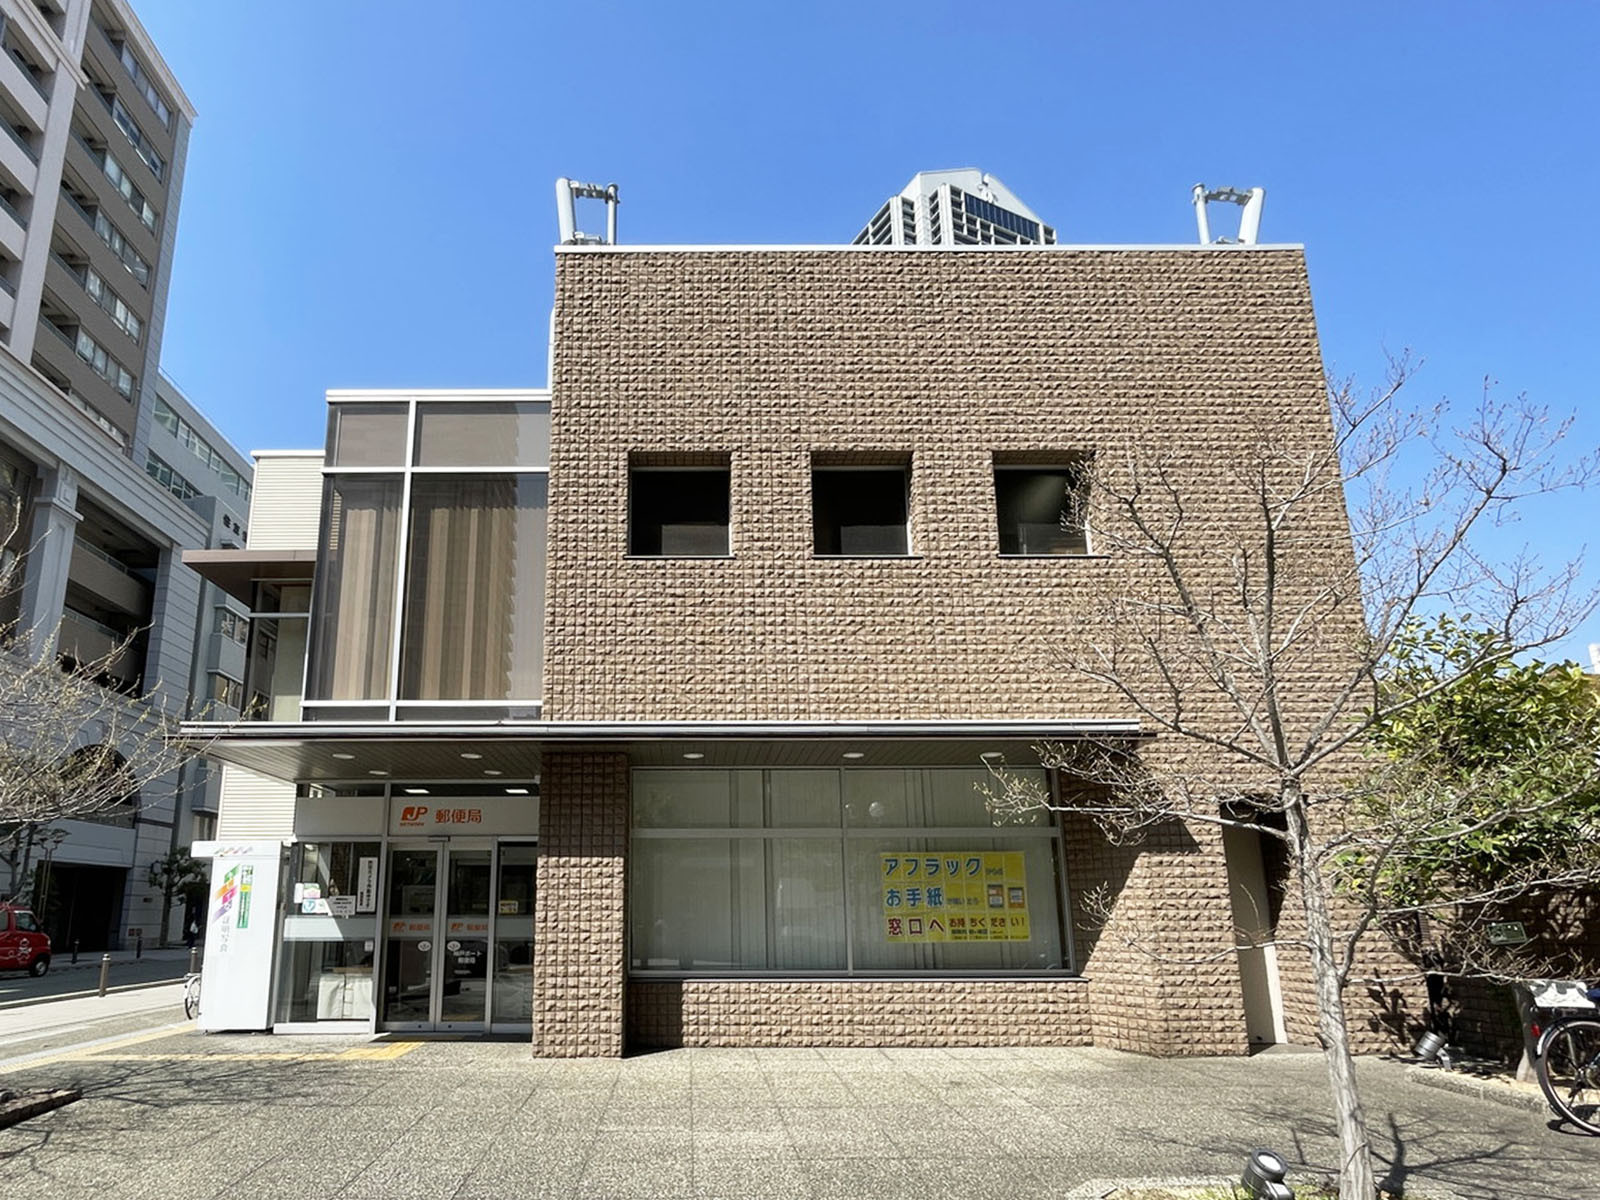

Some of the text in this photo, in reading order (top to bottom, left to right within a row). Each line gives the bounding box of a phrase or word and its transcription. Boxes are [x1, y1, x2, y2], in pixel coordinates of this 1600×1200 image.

[435, 808, 482, 824] 郵便局
[884, 858, 981, 876] アフラック
[886, 887, 943, 907] お手紙
[888, 917, 945, 936] 窓口へ
